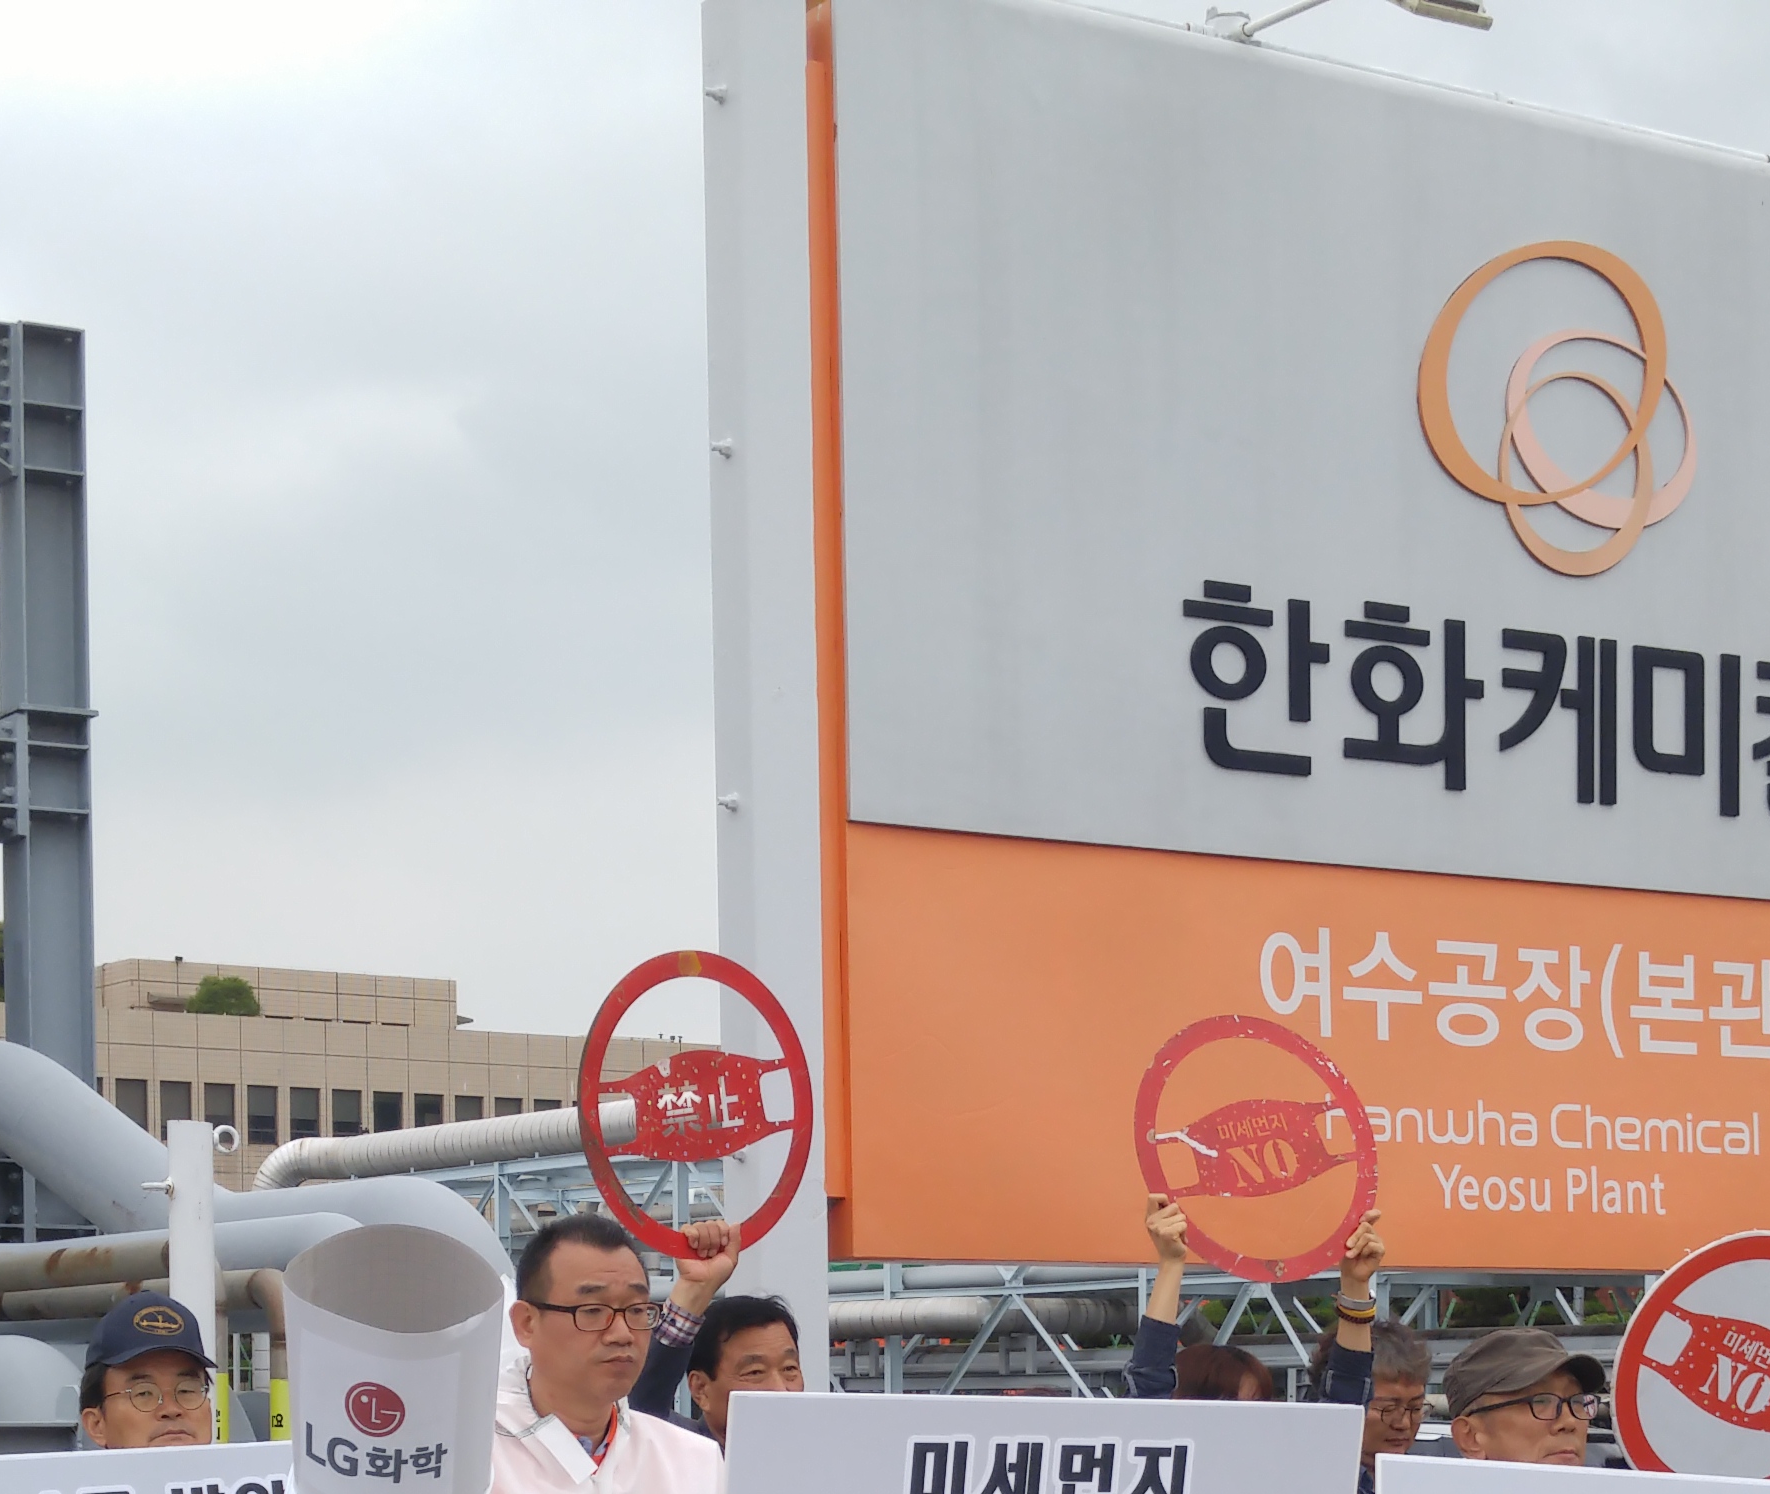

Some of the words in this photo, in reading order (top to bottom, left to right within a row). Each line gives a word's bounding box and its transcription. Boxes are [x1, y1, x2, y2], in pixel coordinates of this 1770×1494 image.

[656, 1075, 745, 1138] 禁止
[1217, 1112, 1288, 1143] 미세먼지
[1550, 1102, 1760, 1156] Chemical
[1226, 1138, 1300, 1188] NO
[1432, 1163, 1551, 1212] Yeosu
[1567, 1166, 1667, 1215] Plant
